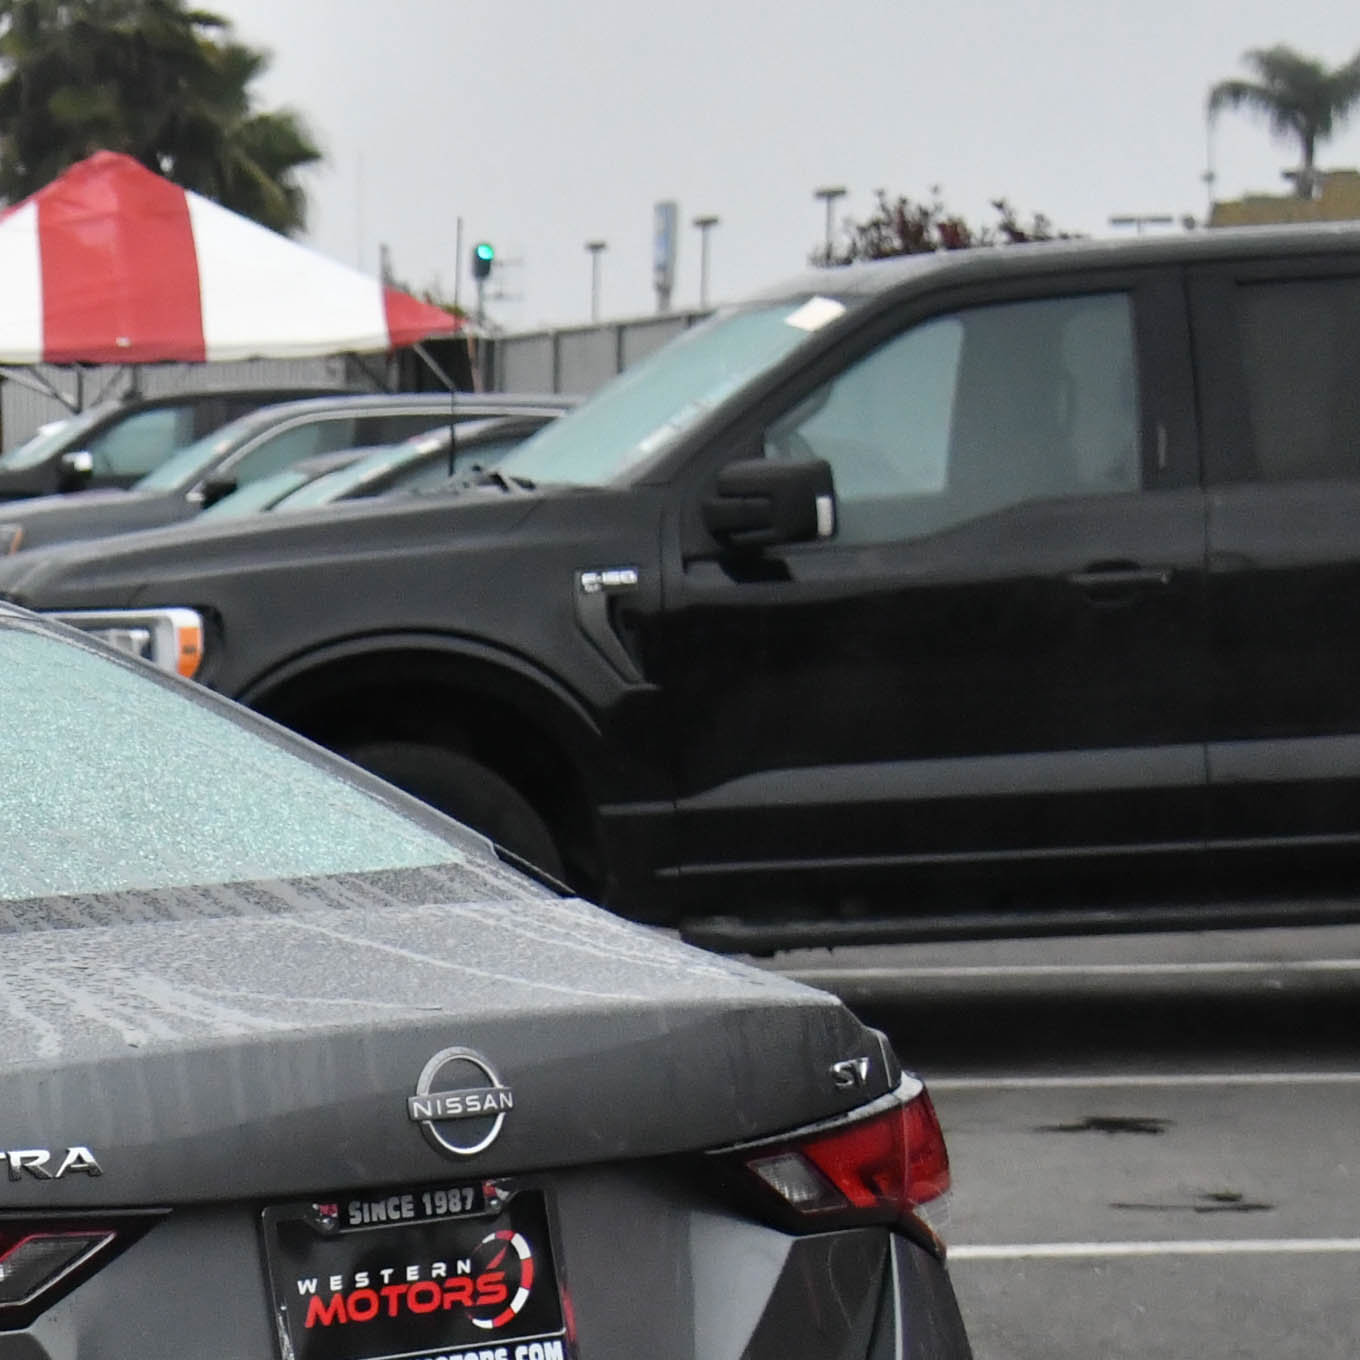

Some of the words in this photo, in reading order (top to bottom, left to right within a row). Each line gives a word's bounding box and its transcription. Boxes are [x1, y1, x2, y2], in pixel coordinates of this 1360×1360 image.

[412, 1092, 513, 1118] NISSAN
[348, 1194, 415, 1225] SINCE
[422, 1187, 474, 1216] 1987
[297, 1259, 472, 1295] WESTERN
[304, 1271, 509, 1329] MOTORS
